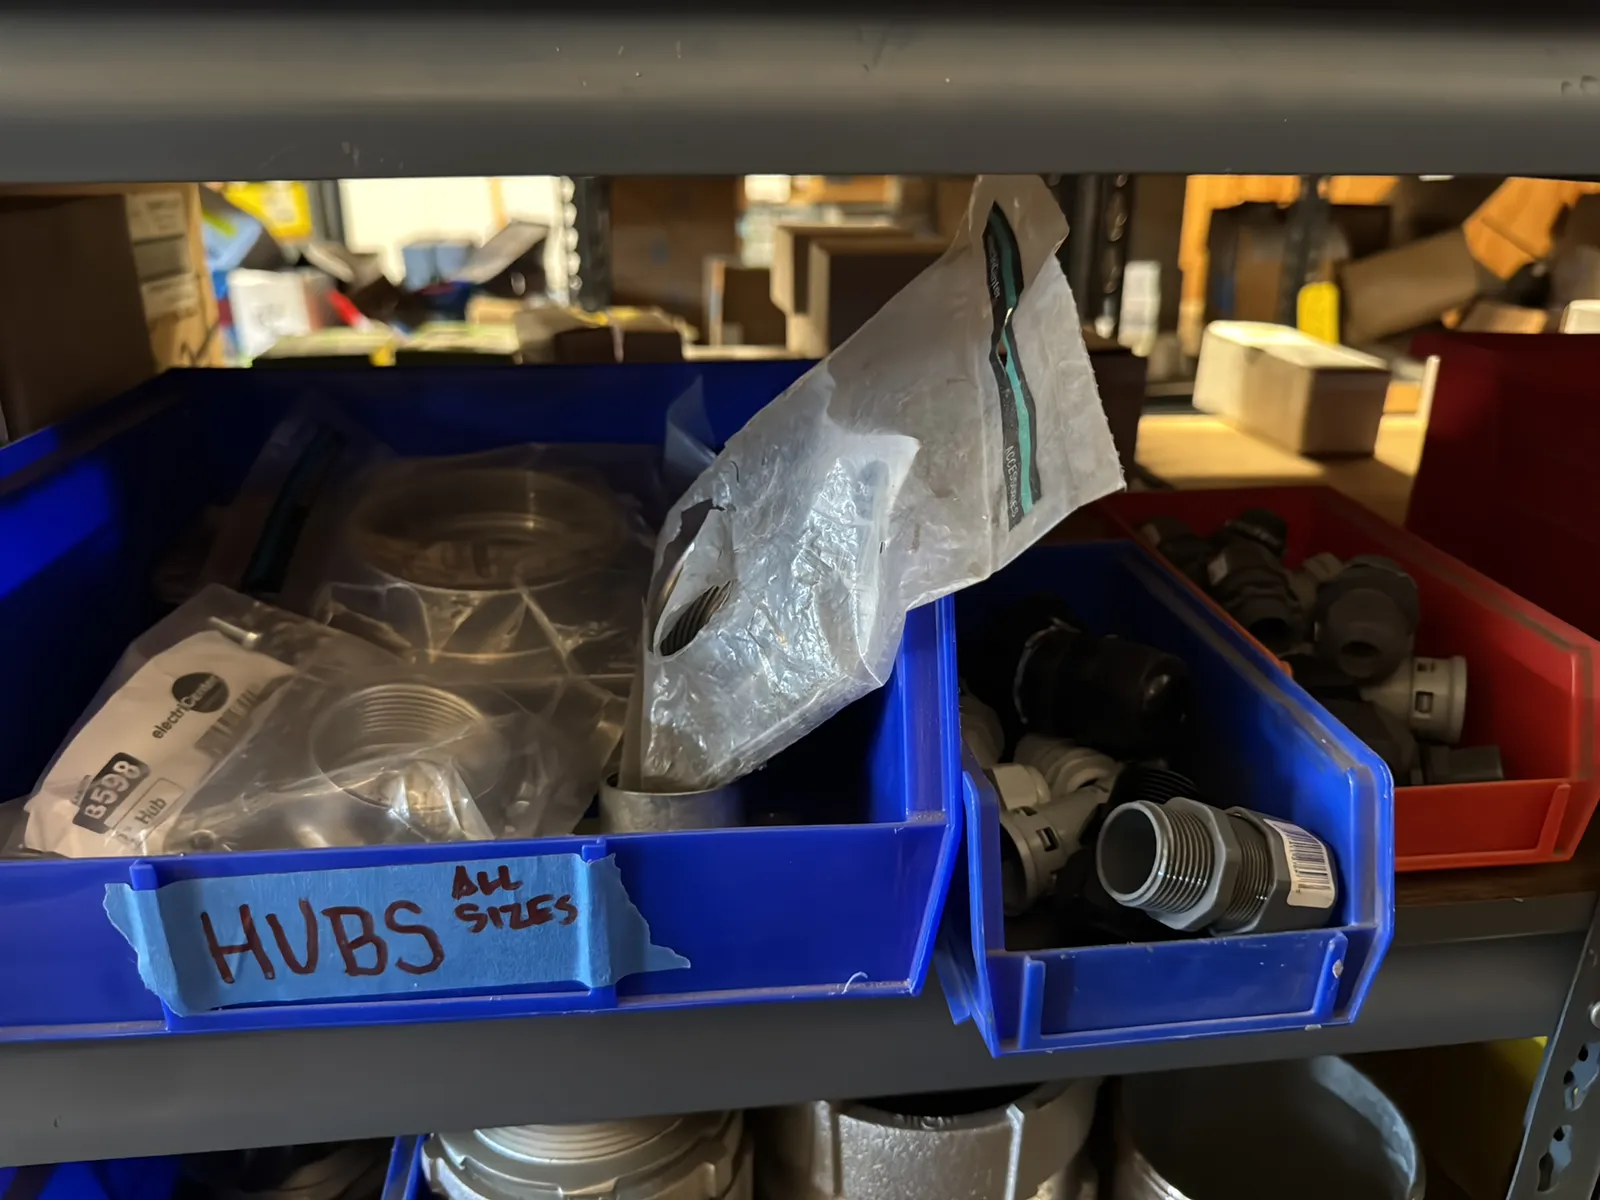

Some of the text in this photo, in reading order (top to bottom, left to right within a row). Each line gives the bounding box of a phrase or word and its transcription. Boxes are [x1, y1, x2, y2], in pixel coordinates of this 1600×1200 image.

[83, 760, 141, 820] B598
[134, 797, 167, 825] Hub
[451, 864, 523, 899] ALL
[454, 894, 579, 933] SIZES
[200, 898, 445, 984] HUBS
